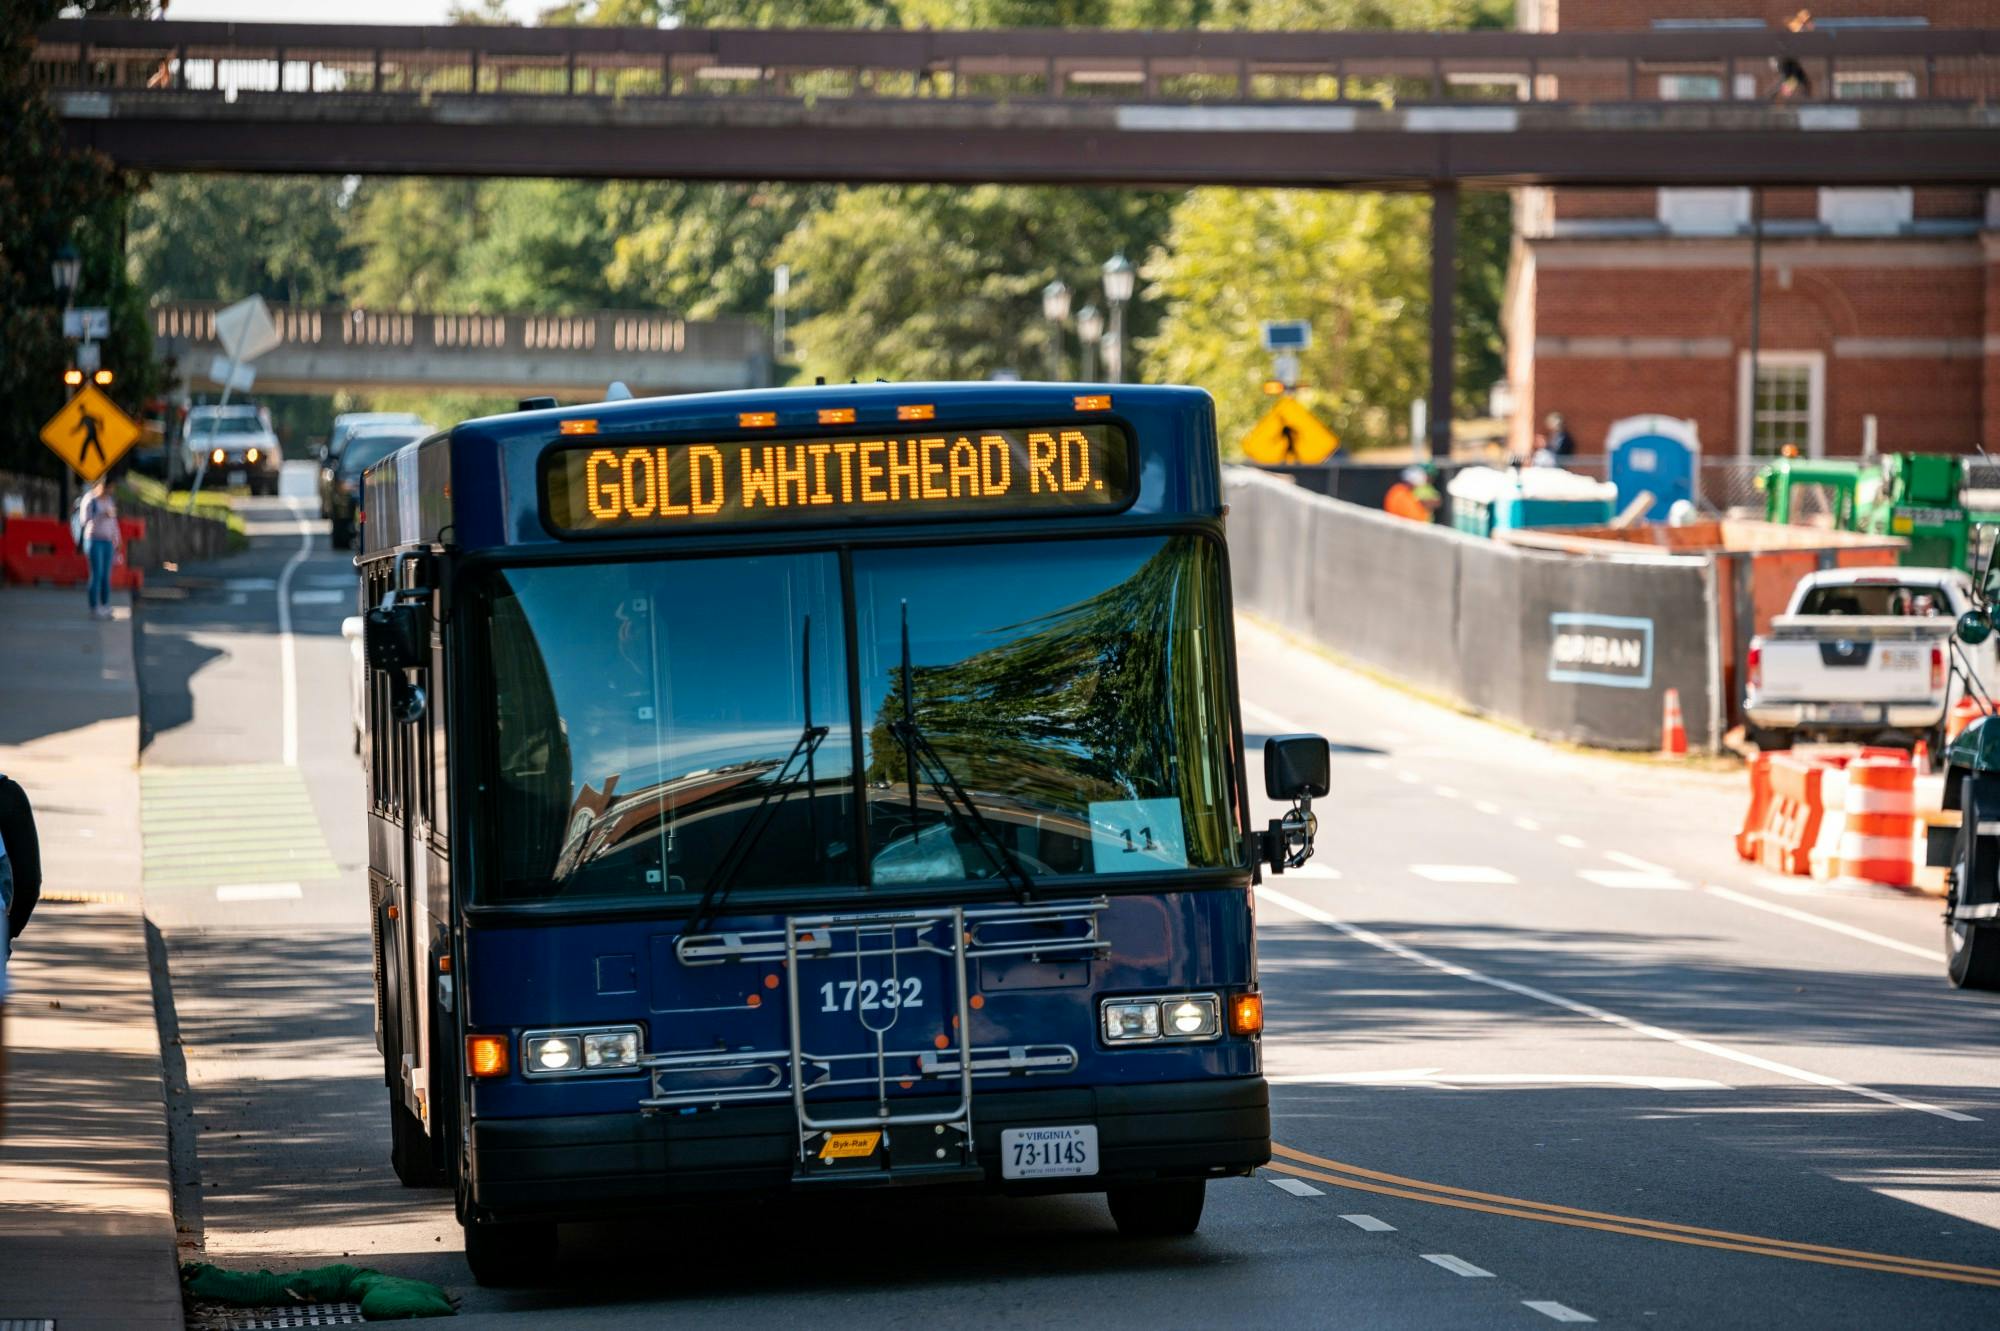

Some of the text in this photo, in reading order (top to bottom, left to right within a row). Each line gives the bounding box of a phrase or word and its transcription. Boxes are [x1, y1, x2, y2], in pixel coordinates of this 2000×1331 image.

[586, 431, 1104, 519] GOLD WHITEHEAD RD.
[1120, 826, 1158, 854] 11
[820, 977, 924, 1013] 17232
[1026, 1130, 1072, 1141] VIRGINIA
